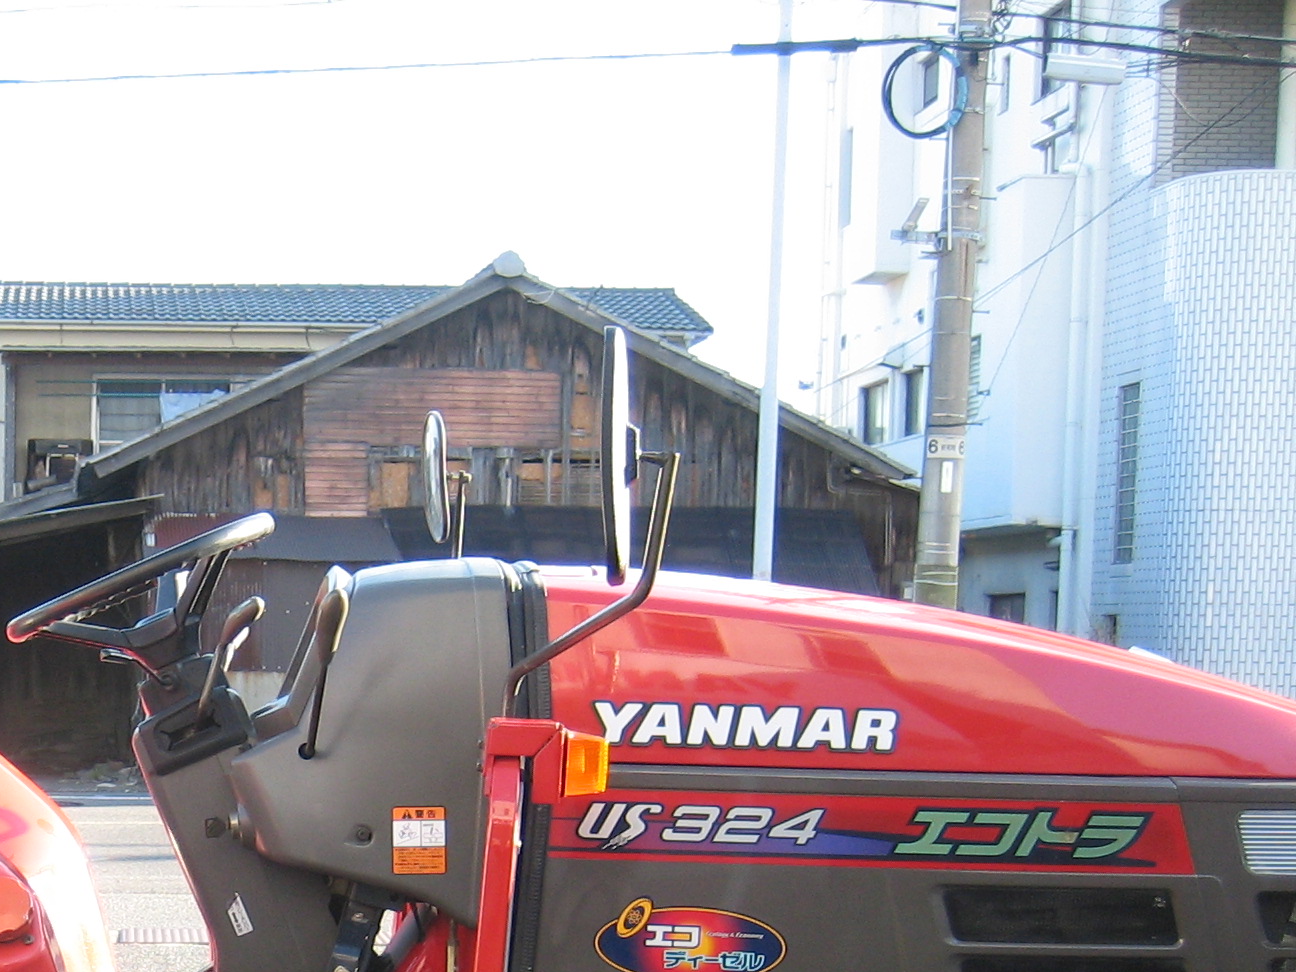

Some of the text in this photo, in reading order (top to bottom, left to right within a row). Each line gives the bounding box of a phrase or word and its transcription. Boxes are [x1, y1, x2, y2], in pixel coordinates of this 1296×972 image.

[593, 700, 898, 752] YANMAR
[893, 810, 1146, 859] エコトラ
[645, 924, 702, 948] エコ
[664, 950, 766, 971] ディーゼル
